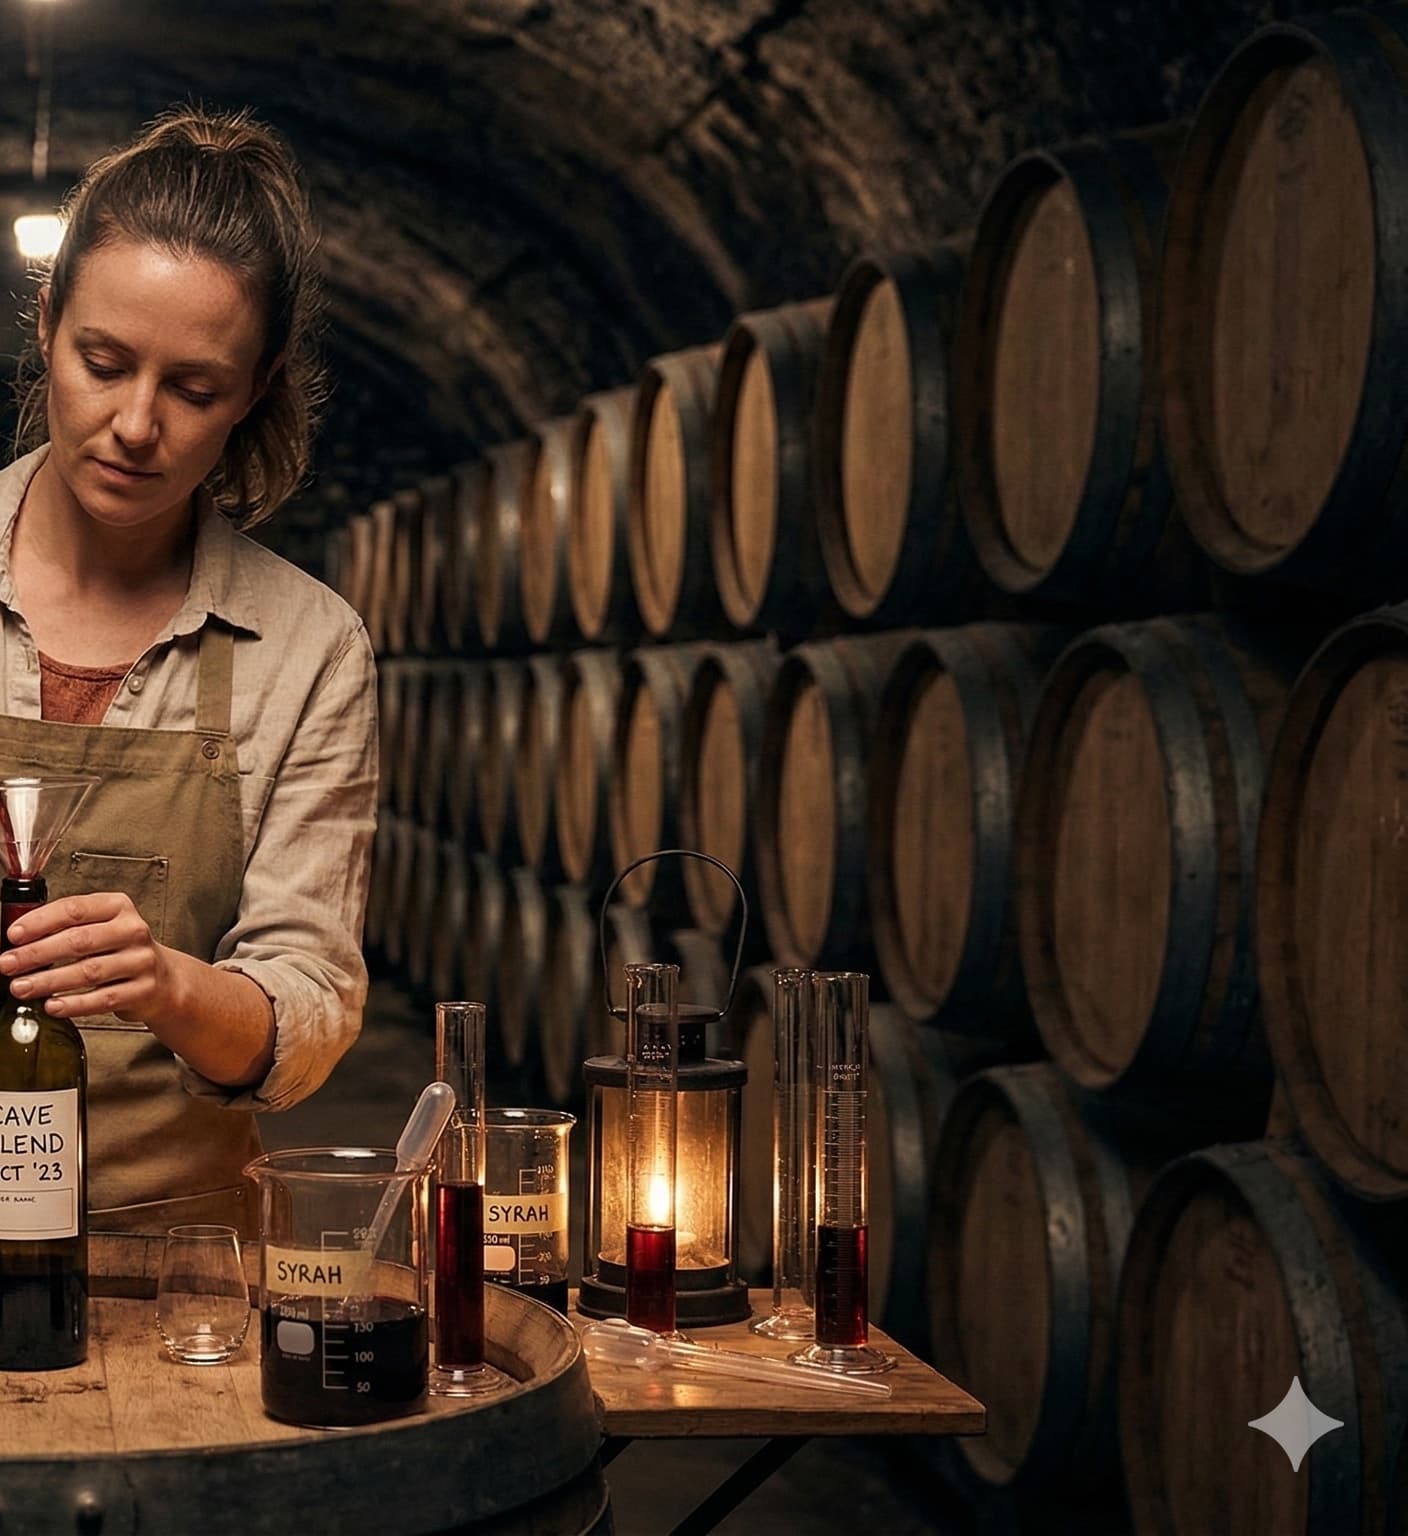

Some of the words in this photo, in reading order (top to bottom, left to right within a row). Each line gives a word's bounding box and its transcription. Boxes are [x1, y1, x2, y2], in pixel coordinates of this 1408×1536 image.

[33, 1161, 63, 1181] '23
[489, 1205, 549, 1223] SYRAH
[277, 1260, 342, 1285] SYRAH
[354, 1351, 374, 1362] 100
[356, 1381, 371, 1393] 50
